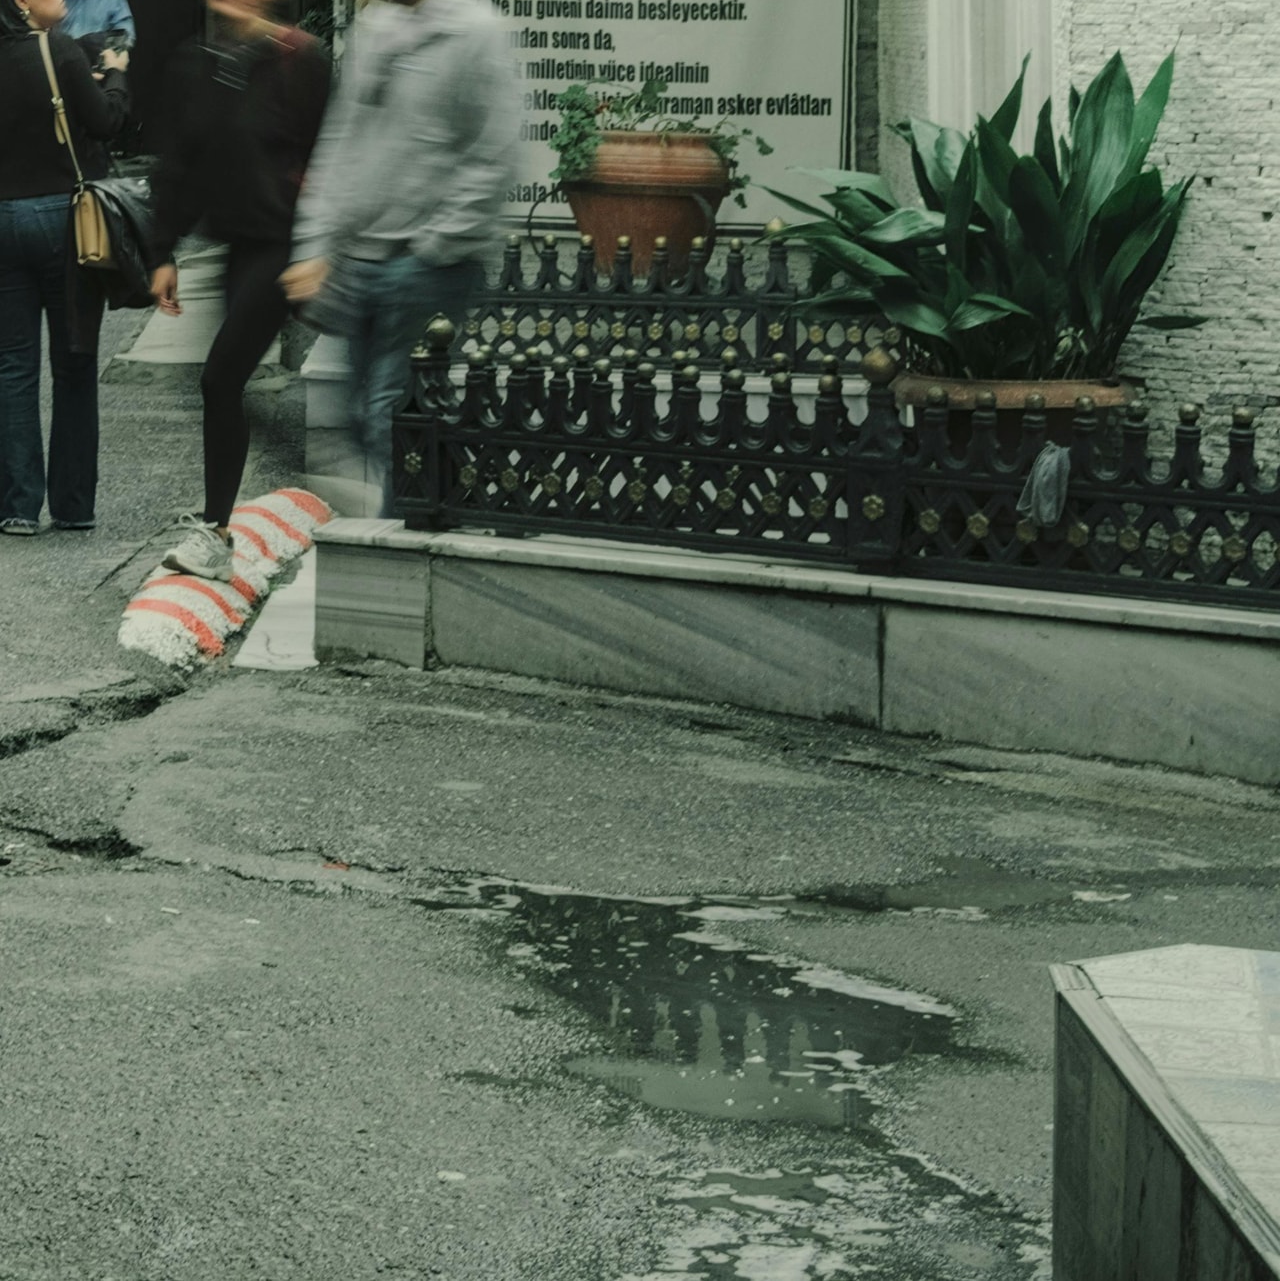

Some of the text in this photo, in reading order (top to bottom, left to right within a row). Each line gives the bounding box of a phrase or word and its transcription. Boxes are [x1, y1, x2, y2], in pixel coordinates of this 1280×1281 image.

[552, 30, 590, 50] sonra
[594, 29, 616, 52] da,
[526, 58, 595, 80] milletinin
[598, 60, 636, 82] yüce
[639, 61, 709, 83] idealinin
[717, 95, 761, 117] asker
[766, 93, 832, 116] evlâtları
